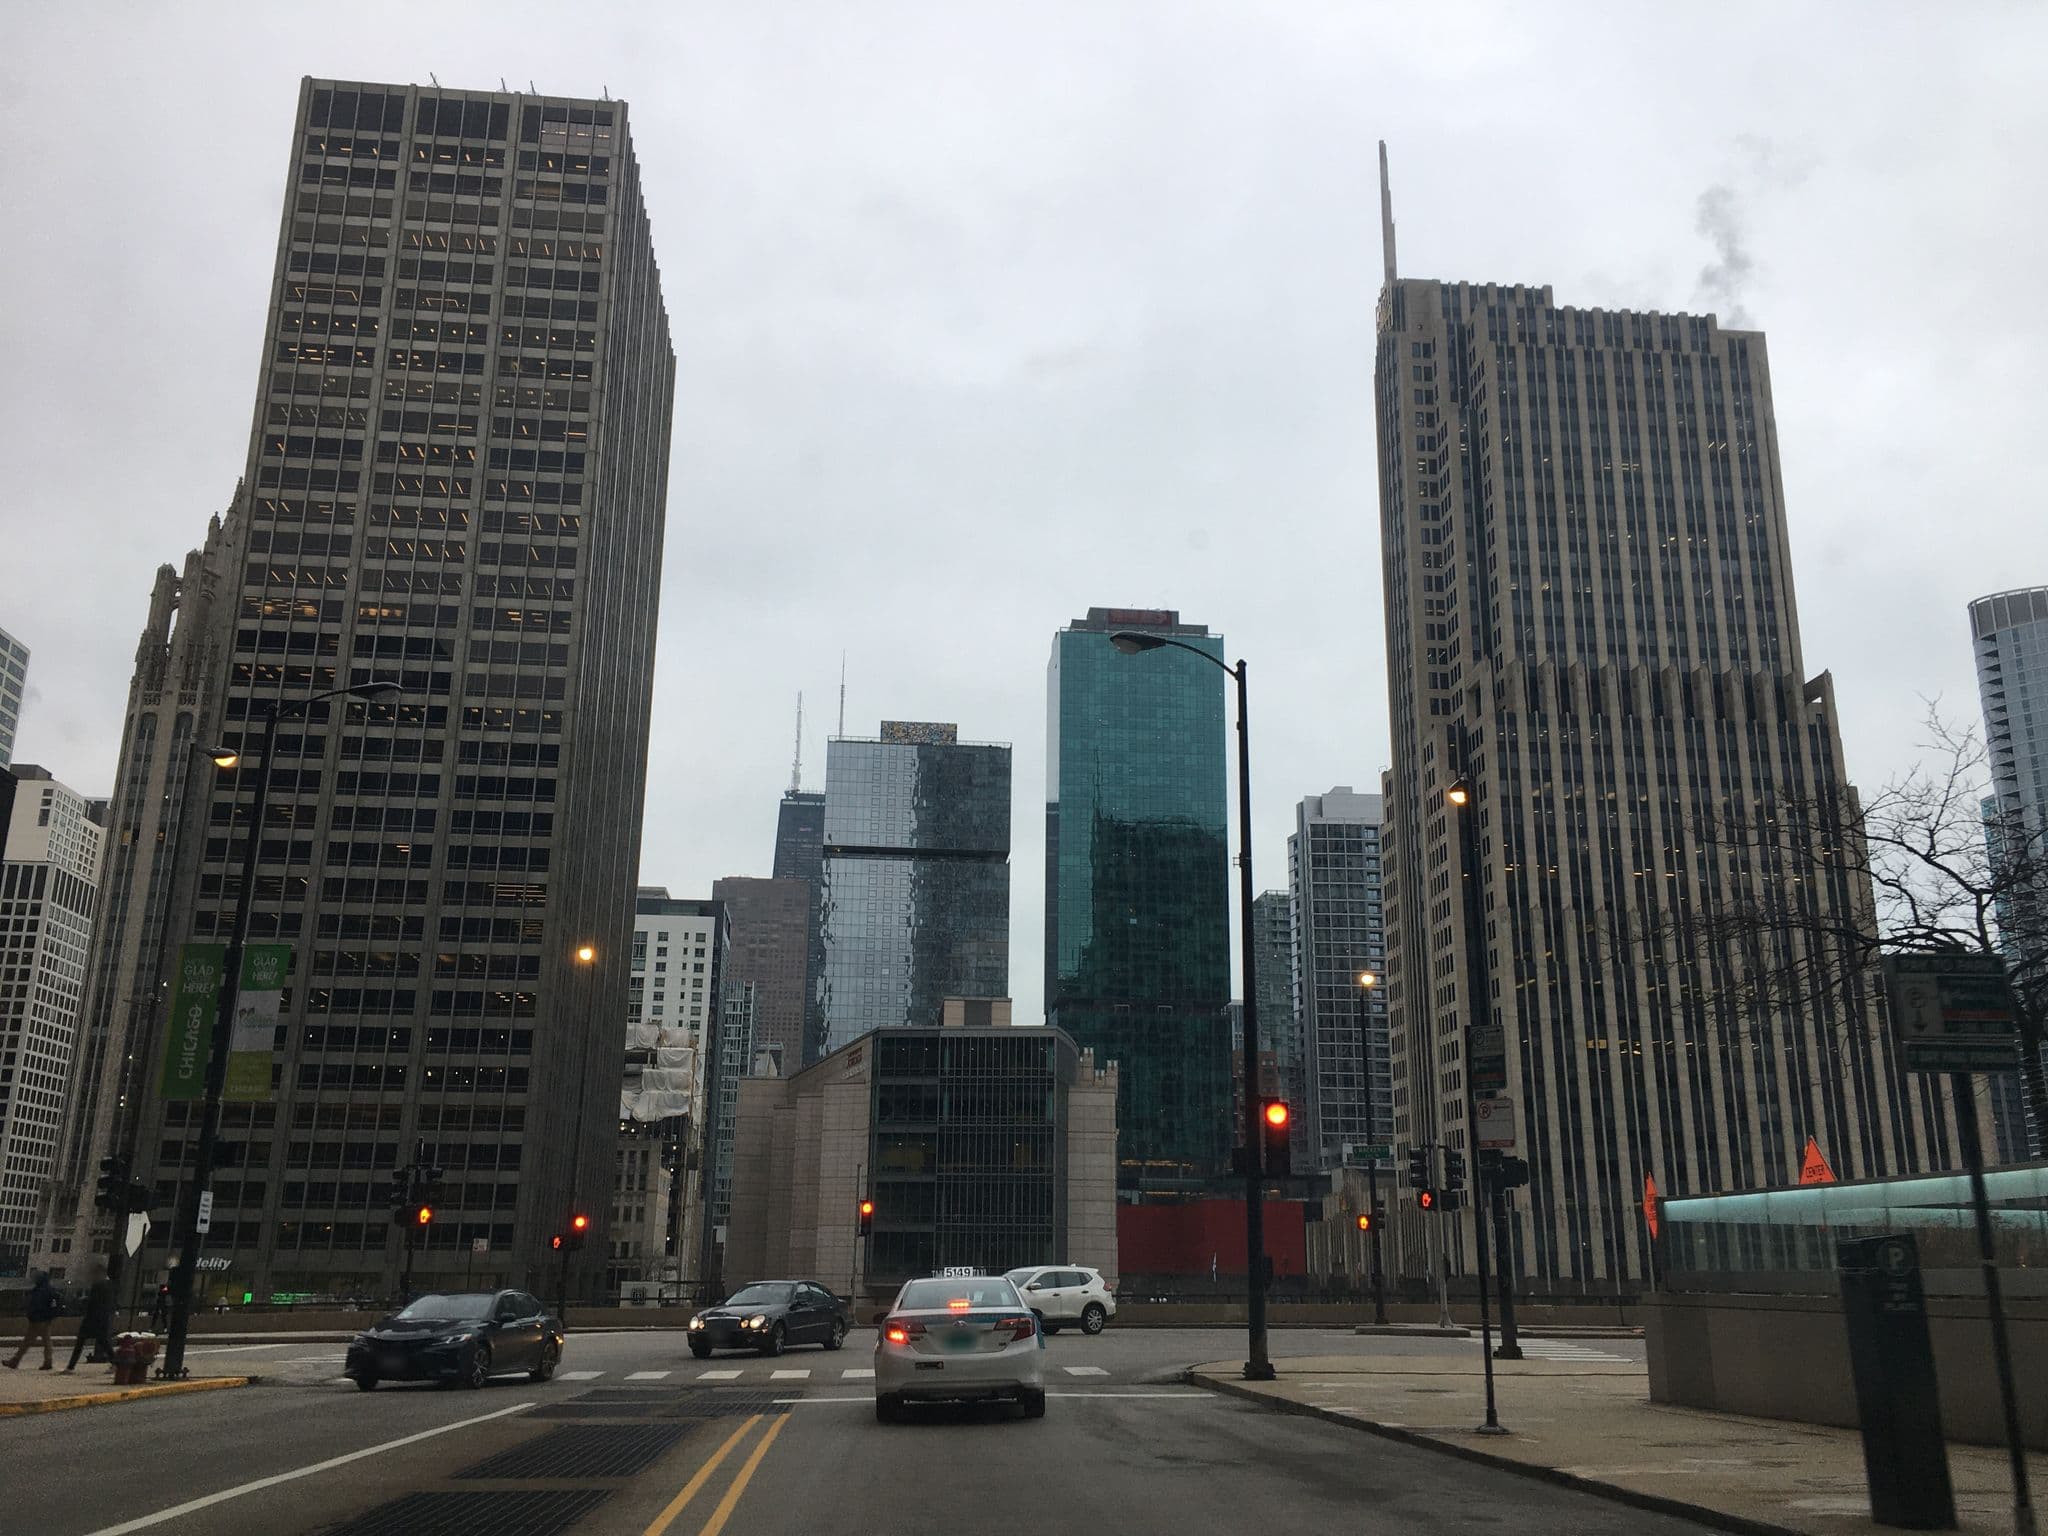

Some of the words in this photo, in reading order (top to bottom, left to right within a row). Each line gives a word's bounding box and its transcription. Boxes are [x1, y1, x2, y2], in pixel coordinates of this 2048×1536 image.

[254, 956, 278, 967] GLAD
[184, 965, 214, 977] GLAD
[179, 1005, 204, 1079] CHICAGO
[195, 1257, 232, 1271] delity
[946, 1267, 971, 1277] 5149
